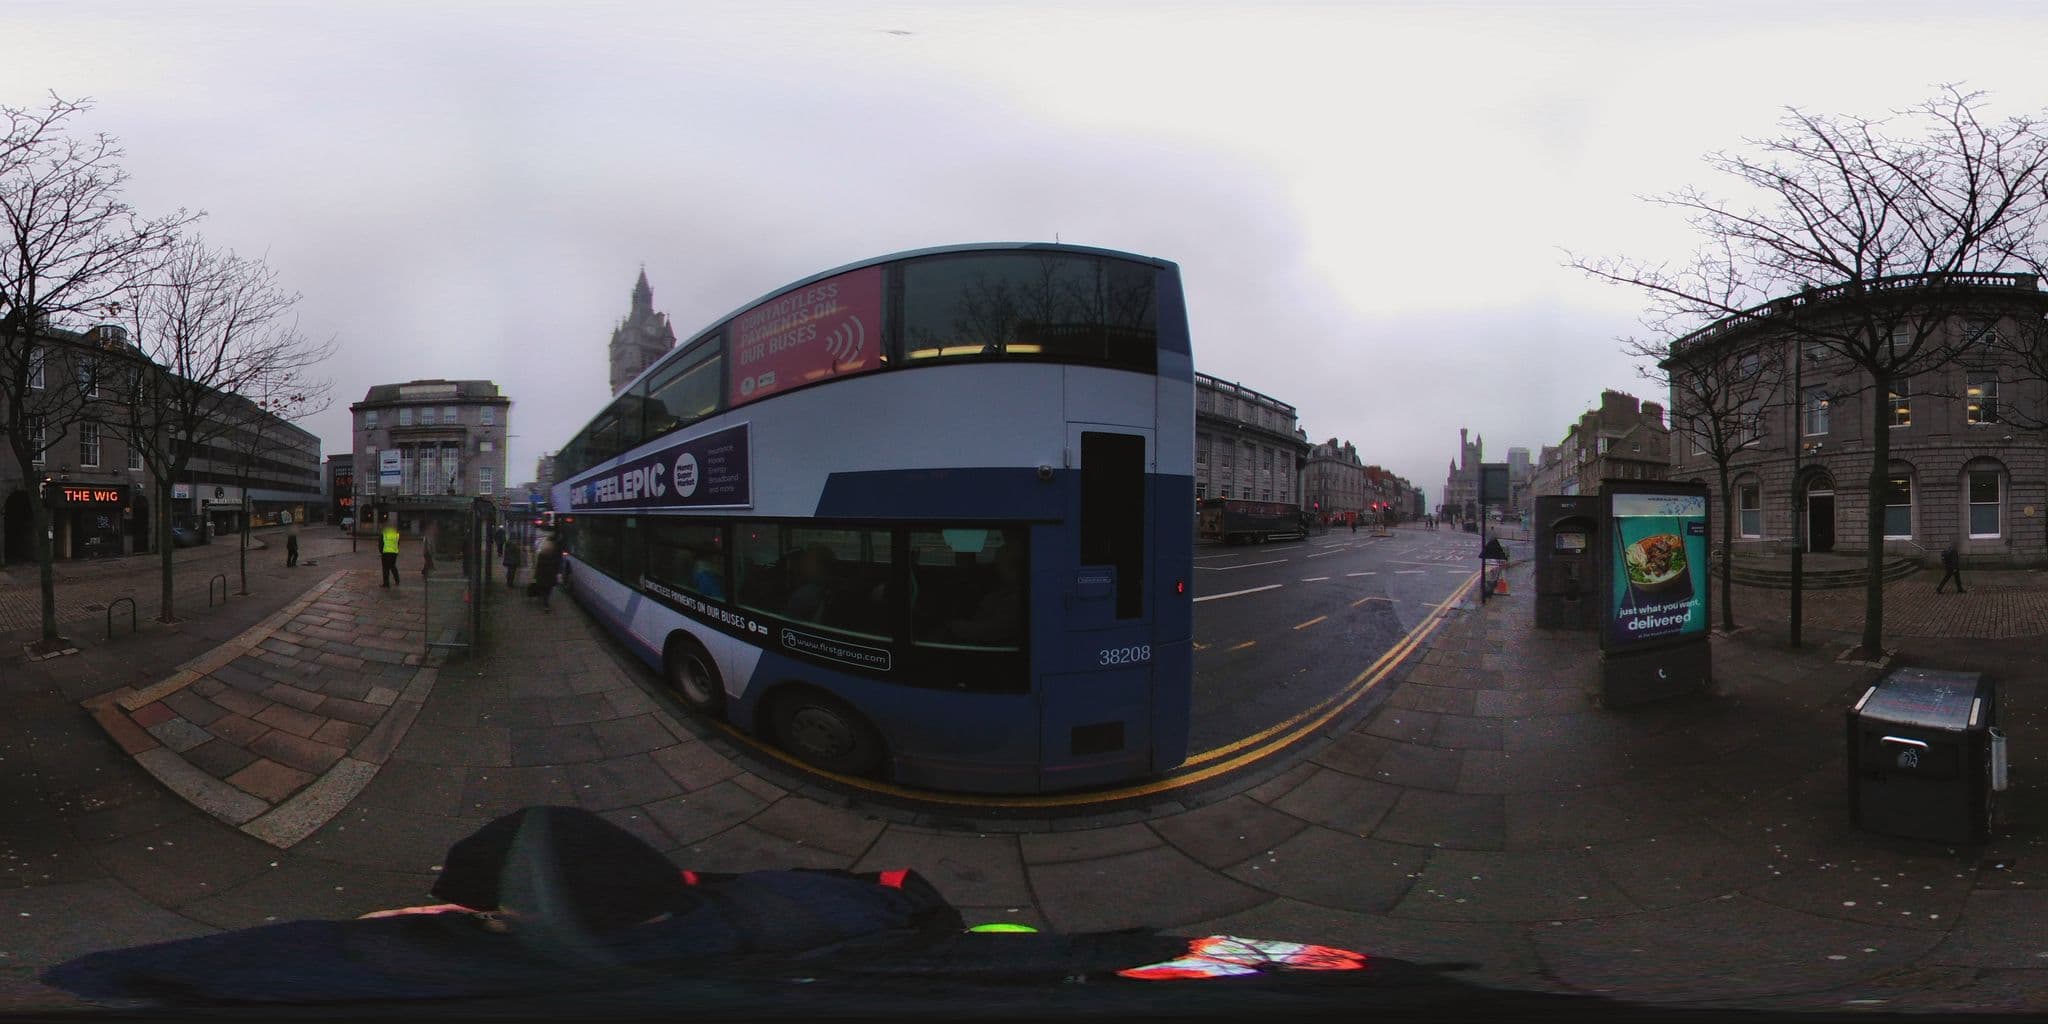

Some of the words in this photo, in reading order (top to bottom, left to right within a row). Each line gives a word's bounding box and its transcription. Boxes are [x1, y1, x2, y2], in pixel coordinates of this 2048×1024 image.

[743, 283, 837, 331] CONTACTLESS
[742, 305, 809, 348] PAYMENTS
[815, 299, 837, 319] ON
[741, 344, 765, 365] OUR
[770, 324, 817, 354] BUSES
[64, 490, 90, 502] THE
[94, 490, 118, 502] WIG
[594, 475, 622, 504] FEEL
[623, 462, 666, 500] EPIC
[671, 590, 696, 610] PAYMENTS
[697, 601, 706, 614] ON
[707, 604, 720, 620] OUR
[721, 610, 746, 629] BUSES
[1619, 607, 1637, 619] just
[1639, 604, 1662, 614] what
[1663, 602, 1678, 613] you
[1628, 609, 1691, 631] delivered
[797, 638, 886, 664] www.firstgroup.com
[1099, 645, 1151, 665] 38208
